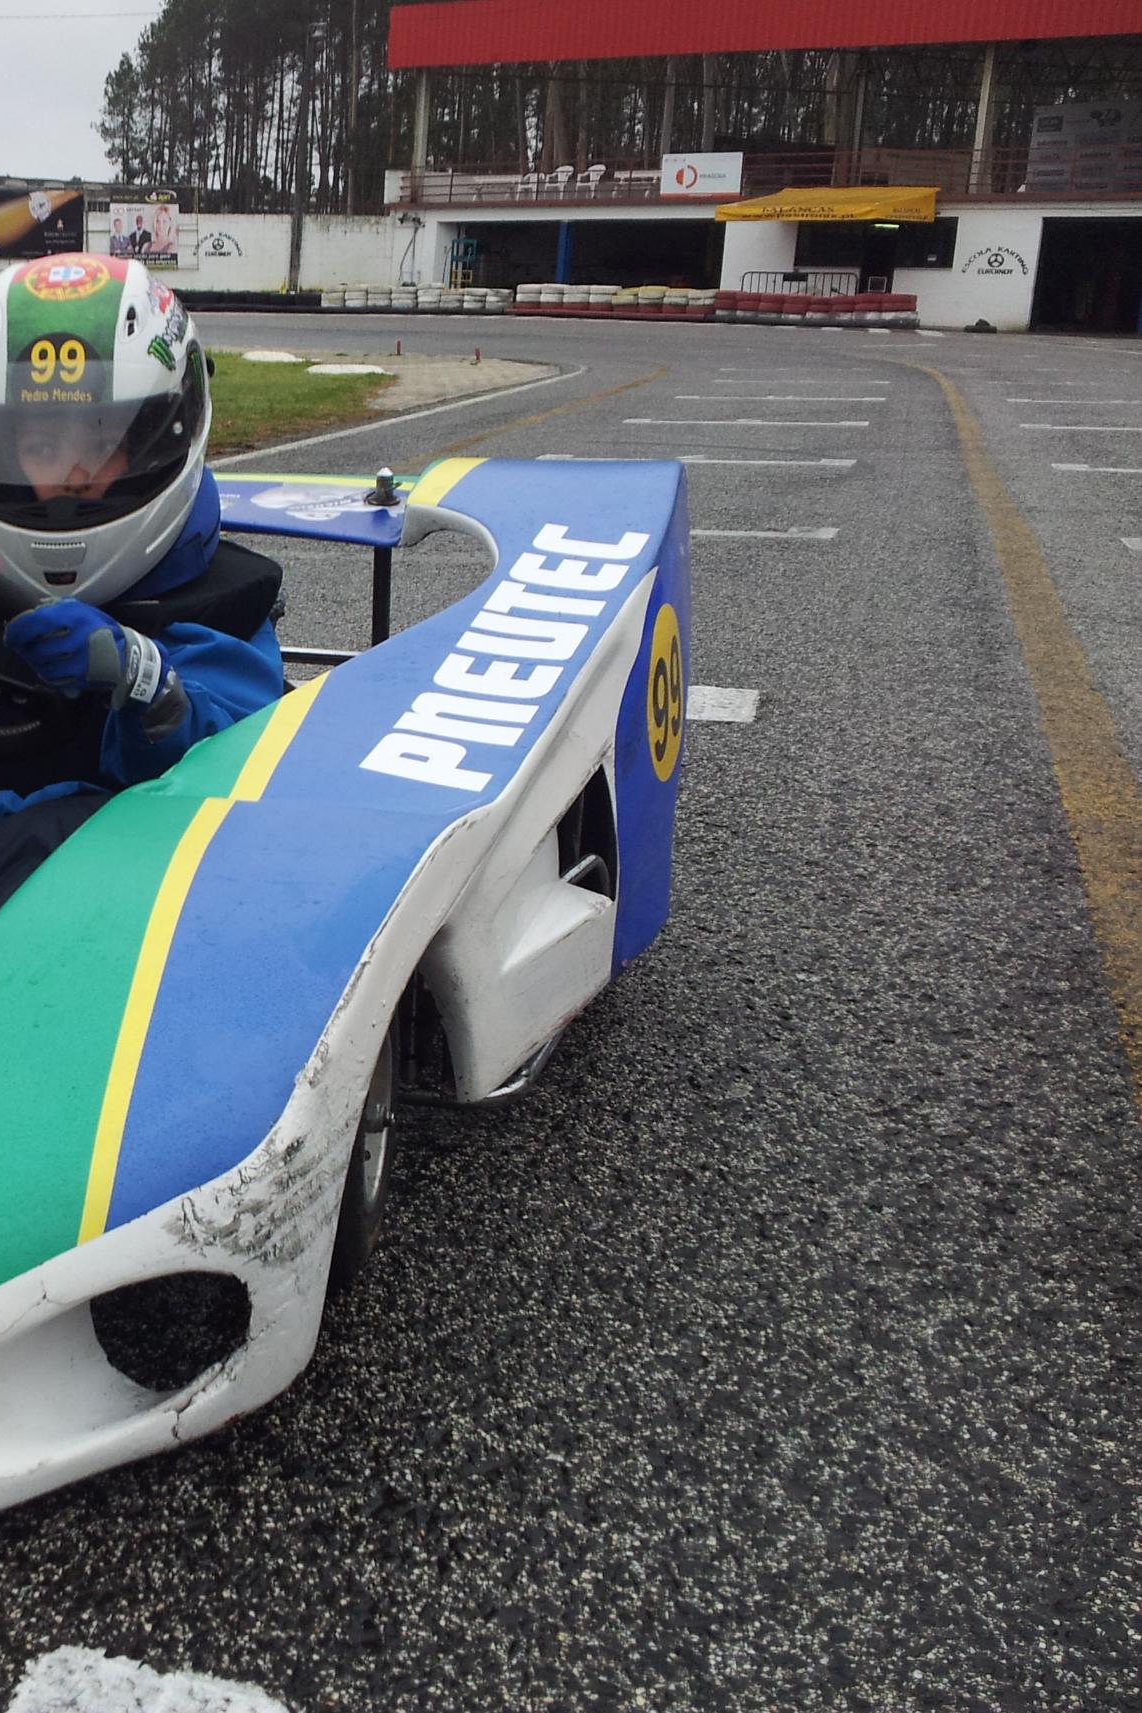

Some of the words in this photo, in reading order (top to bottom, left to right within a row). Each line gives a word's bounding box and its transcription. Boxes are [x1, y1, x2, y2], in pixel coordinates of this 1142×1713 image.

[961, 247, 992, 273] ESCOLA
[997, 246, 1028, 275] KARTING
[30, 339, 86, 384] 99
[21, 388, 49, 402] Pedro
[52, 388, 92, 402] Mendes
[652, 635, 683, 763] 99
